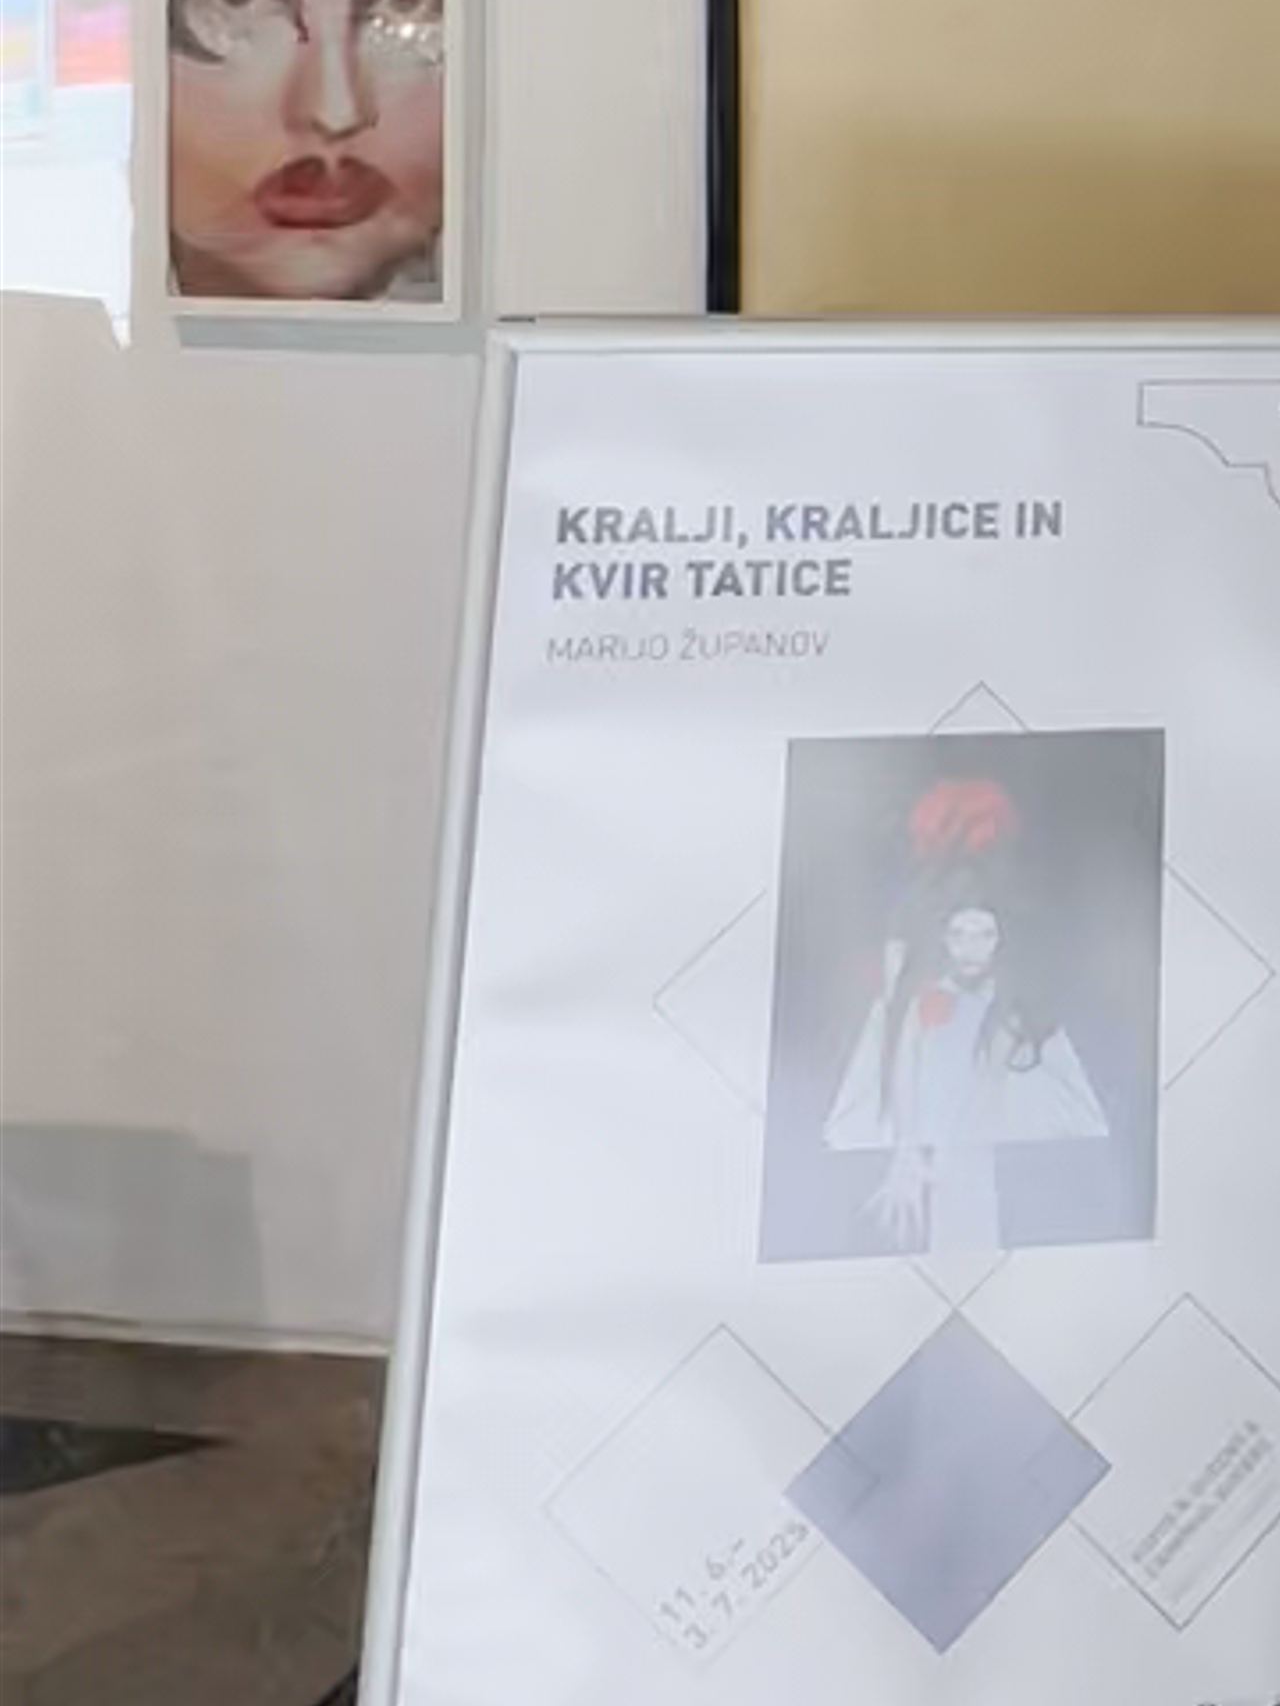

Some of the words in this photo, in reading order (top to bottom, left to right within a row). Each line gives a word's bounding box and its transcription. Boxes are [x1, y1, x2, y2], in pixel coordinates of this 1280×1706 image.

[556, 506, 749, 549] KRALJI,
[765, 502, 1000, 541] KRALJICE
[1014, 501, 1064, 538] IN
[551, 562, 670, 600] KVIR
[685, 559, 853, 598] TATICE
[678, 627, 832, 661] ŽUPANOV
